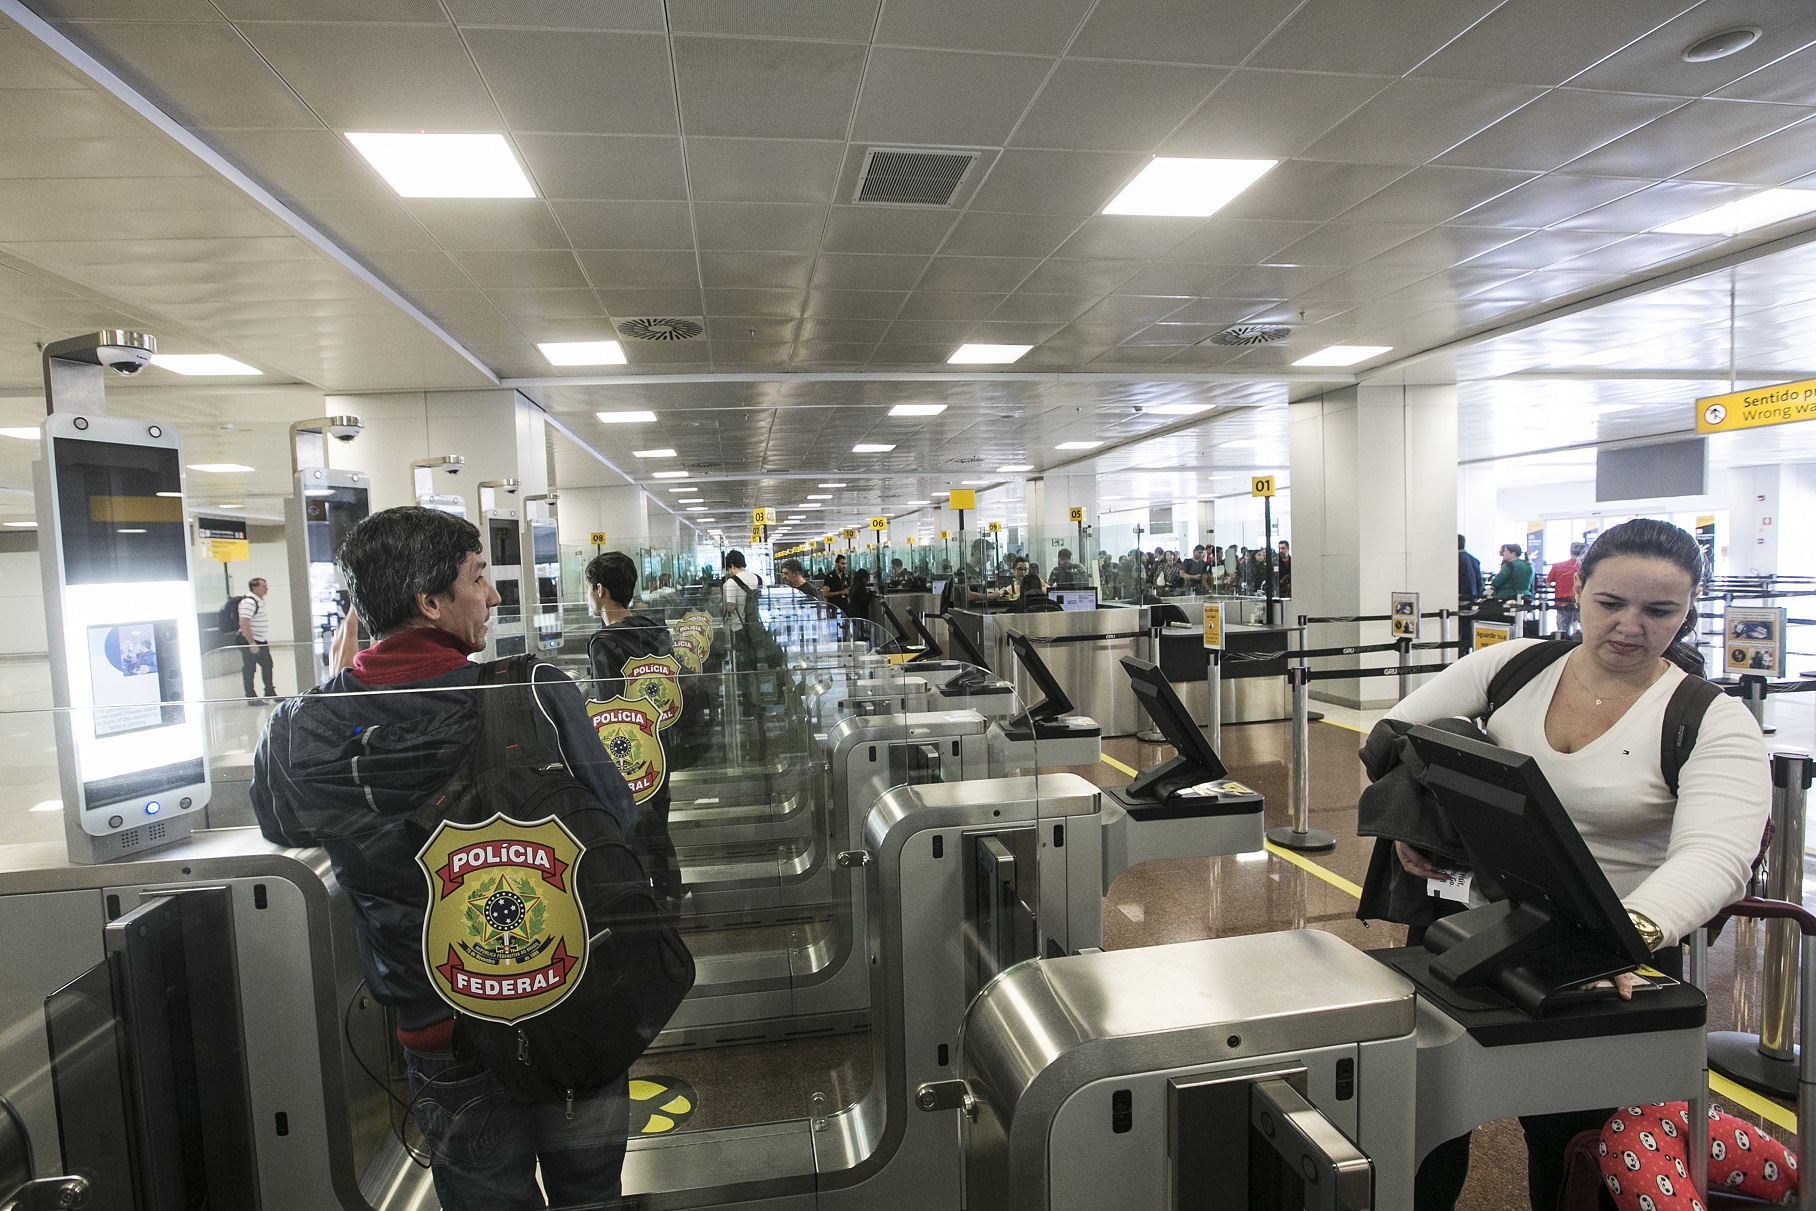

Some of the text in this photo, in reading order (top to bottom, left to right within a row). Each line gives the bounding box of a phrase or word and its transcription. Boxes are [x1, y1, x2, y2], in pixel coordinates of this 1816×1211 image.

[1744, 390, 1799, 408] Sentido
[1743, 406, 1792, 421] Wrong
[1255, 480, 1270, 492] 01
[755, 512, 764, 521] 03
[1071, 510, 1081, 518] 05
[872, 519, 884, 528] 06
[752, 527, 760, 535] 07
[593, 534, 604, 542] 08
[1476, 631, 1496, 639] Aguarde
[674, 640, 692, 648] LÍCIA
[633, 664, 669, 676] POLÍCIA
[593, 710, 645, 727] POLÍCIA
[453, 843, 550, 873] POLÍCIA
[457, 968, 560, 996] FEDERAL
